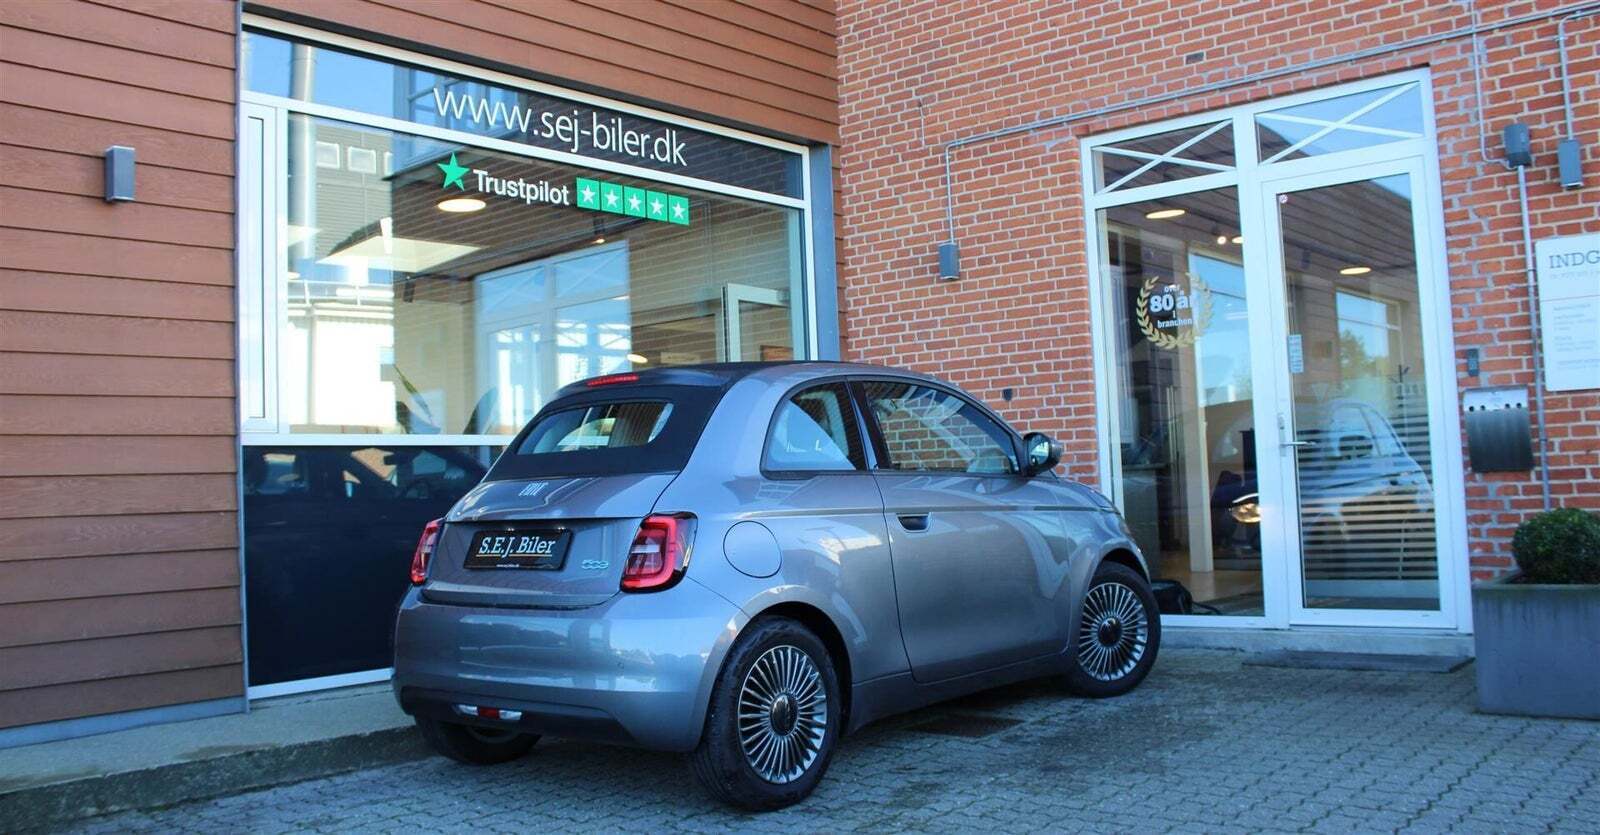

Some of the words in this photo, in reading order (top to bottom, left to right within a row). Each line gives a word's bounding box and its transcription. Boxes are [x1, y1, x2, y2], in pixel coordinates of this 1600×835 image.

[433, 88, 688, 167] www.sej-biler.dk
[472, 169, 570, 206] Trustpilot
[1150, 294, 1174, 312] 80
[1157, 318, 1193, 328] branchen
[478, 536, 514, 558] S.E.J.
[517, 536, 556, 554] Biler
